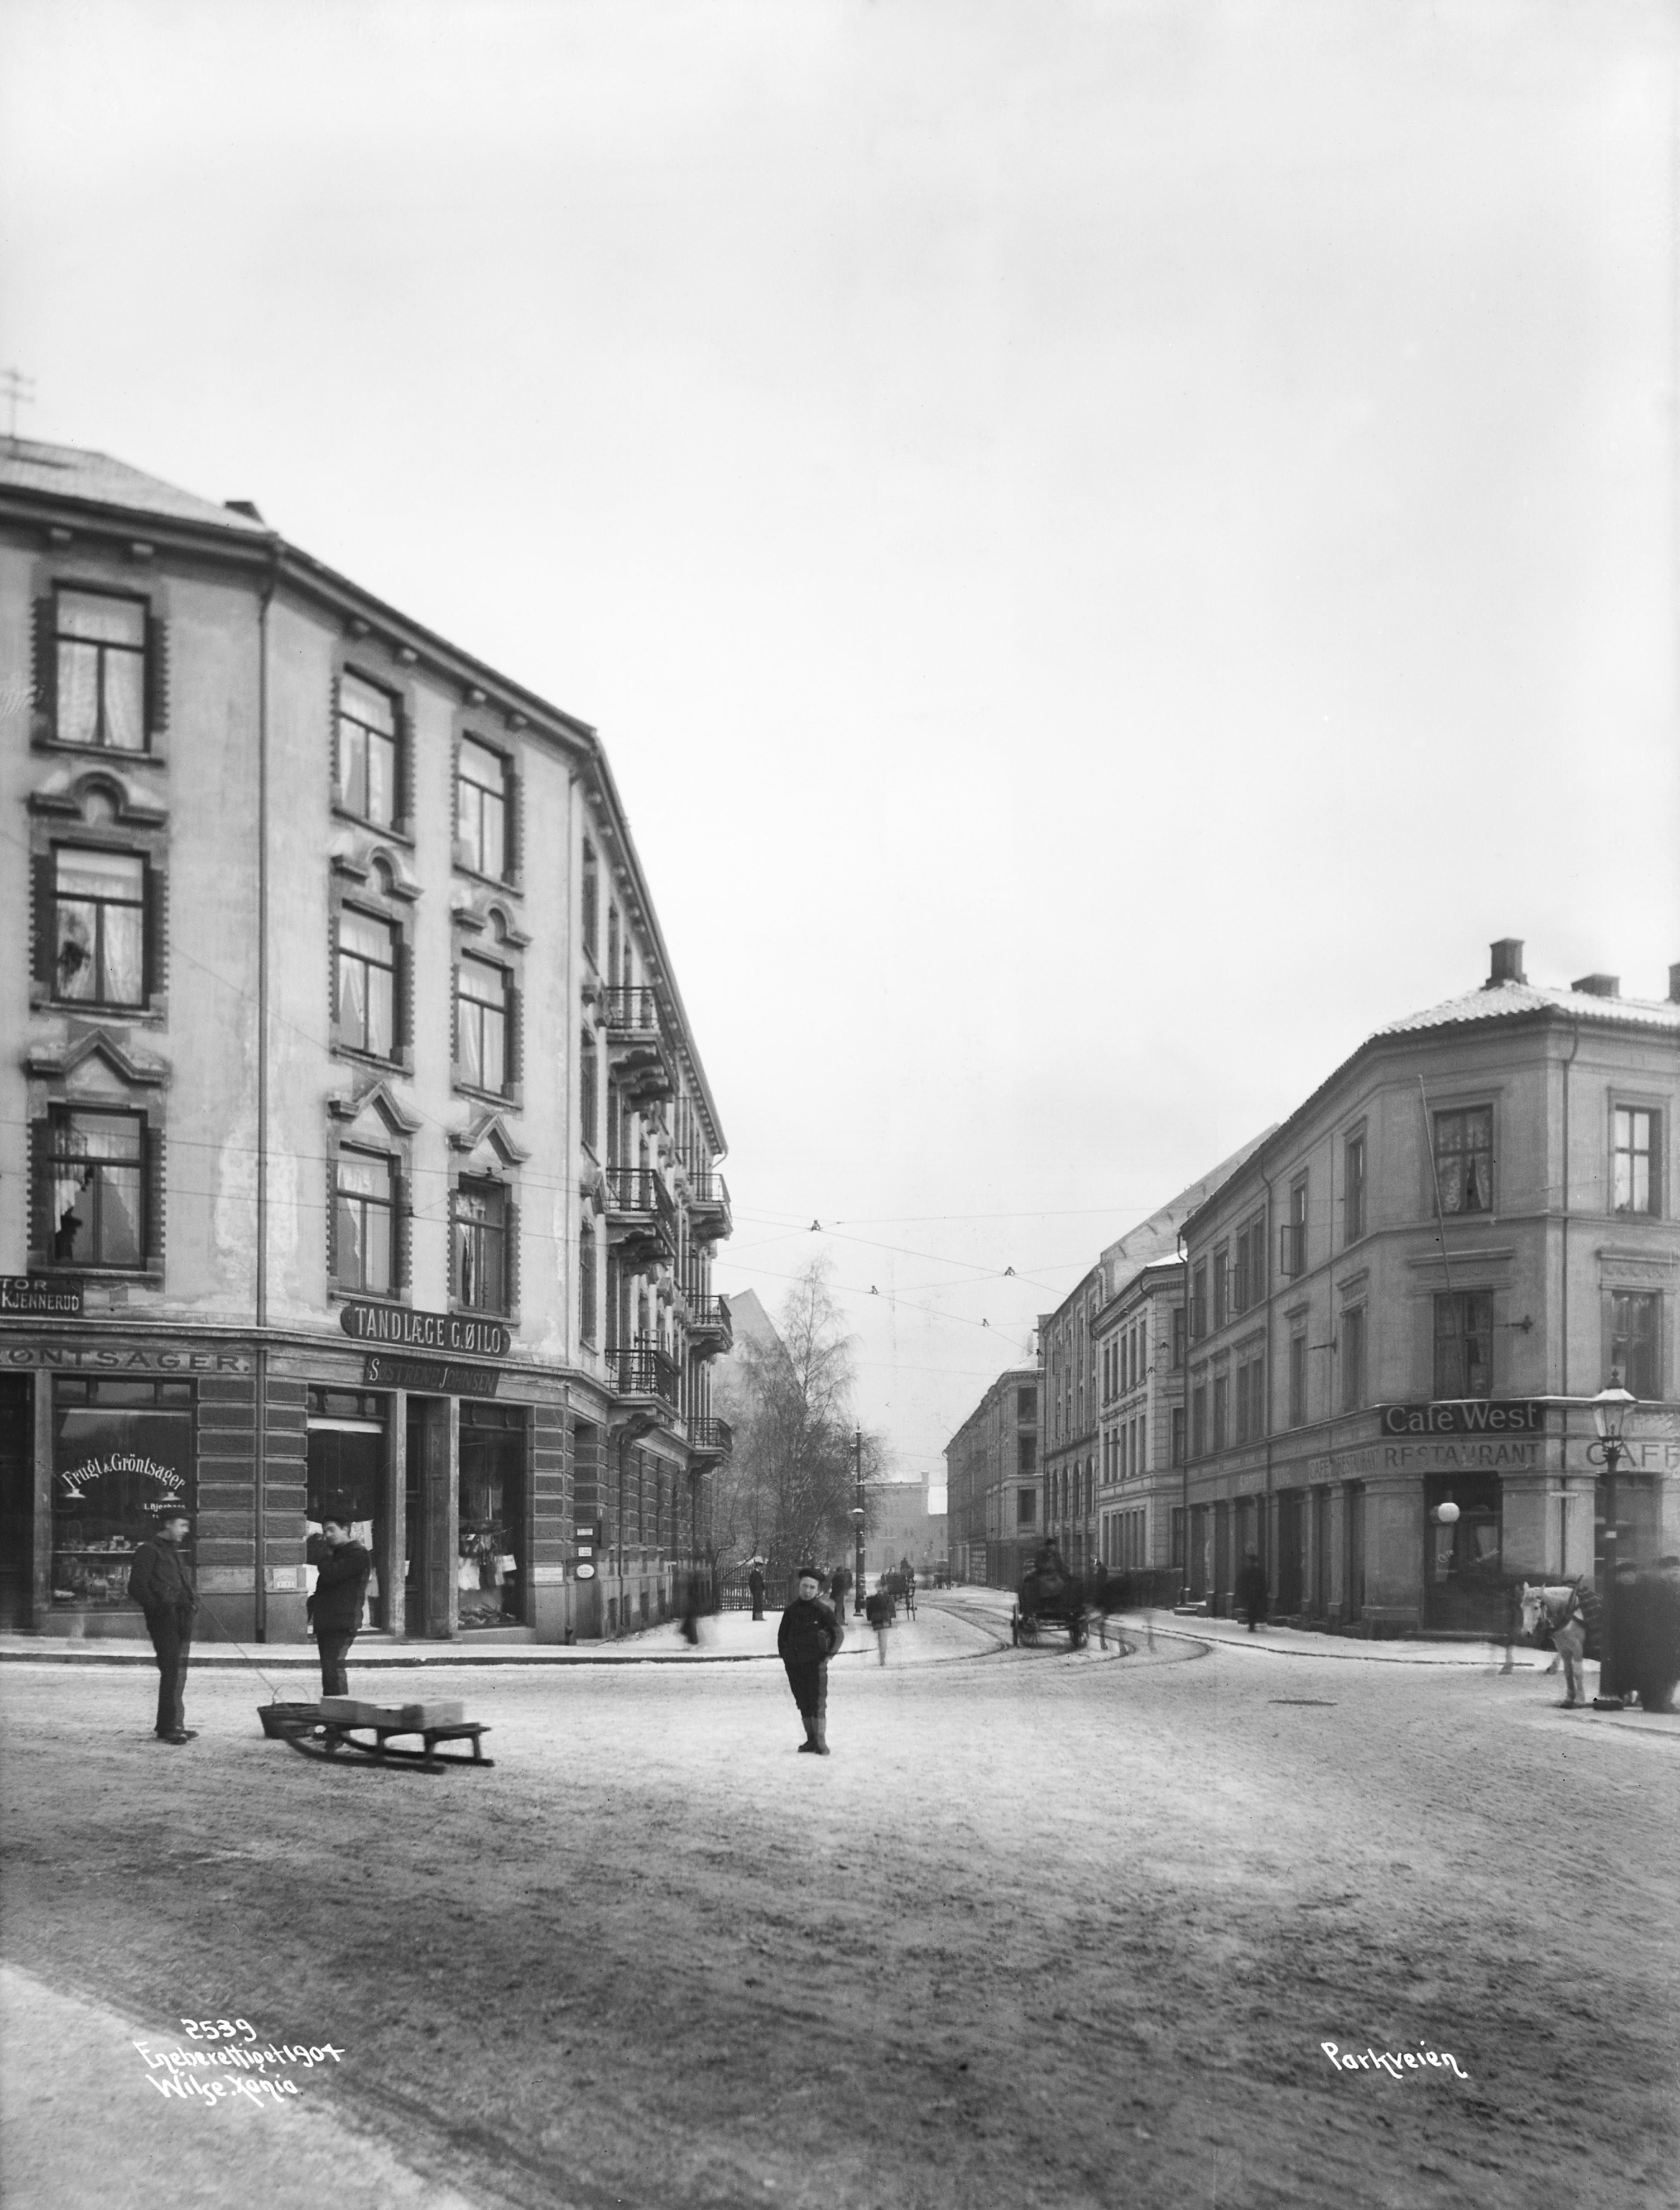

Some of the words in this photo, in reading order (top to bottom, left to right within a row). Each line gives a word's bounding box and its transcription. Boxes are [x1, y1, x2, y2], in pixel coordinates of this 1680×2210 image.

[2, 1291, 79, 1311] KJENNERUD
[354, 1307, 445, 1346] TANDLÆGE
[0, 1348, 250, 1372] ØNTSAGER.
[369, 1358, 440, 1387] SØSTRENE
[438, 1367, 496, 1393] JOHNSEN
[1460, 1402, 1537, 1430] West
[61, 1457, 103, 1489] Frugt
[111, 1452, 186, 1490] Gröntsager
